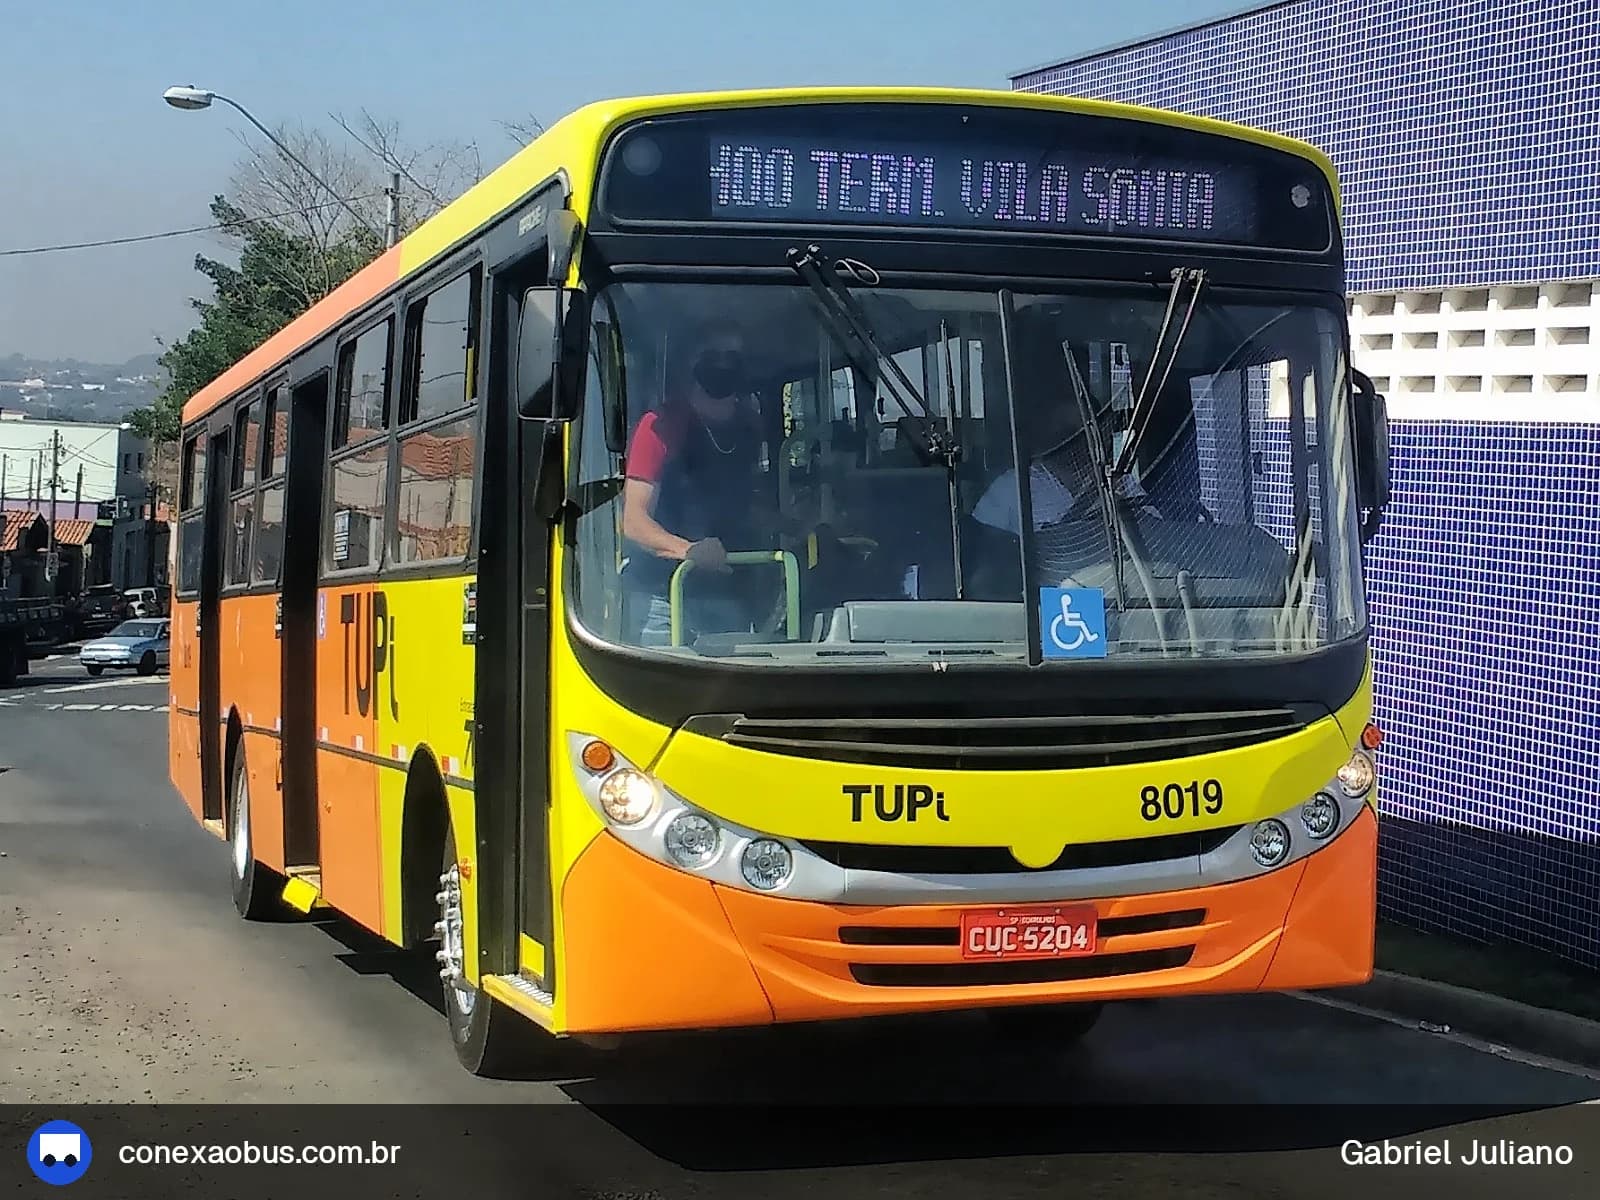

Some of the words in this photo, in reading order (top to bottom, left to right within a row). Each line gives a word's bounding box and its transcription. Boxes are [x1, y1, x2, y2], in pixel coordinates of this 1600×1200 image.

[810, 150, 945, 216] TERM.
[961, 159, 1068, 222] VILA
[1140, 779, 1224, 822] 8019
[969, 924, 1088, 952] CUC-5204
